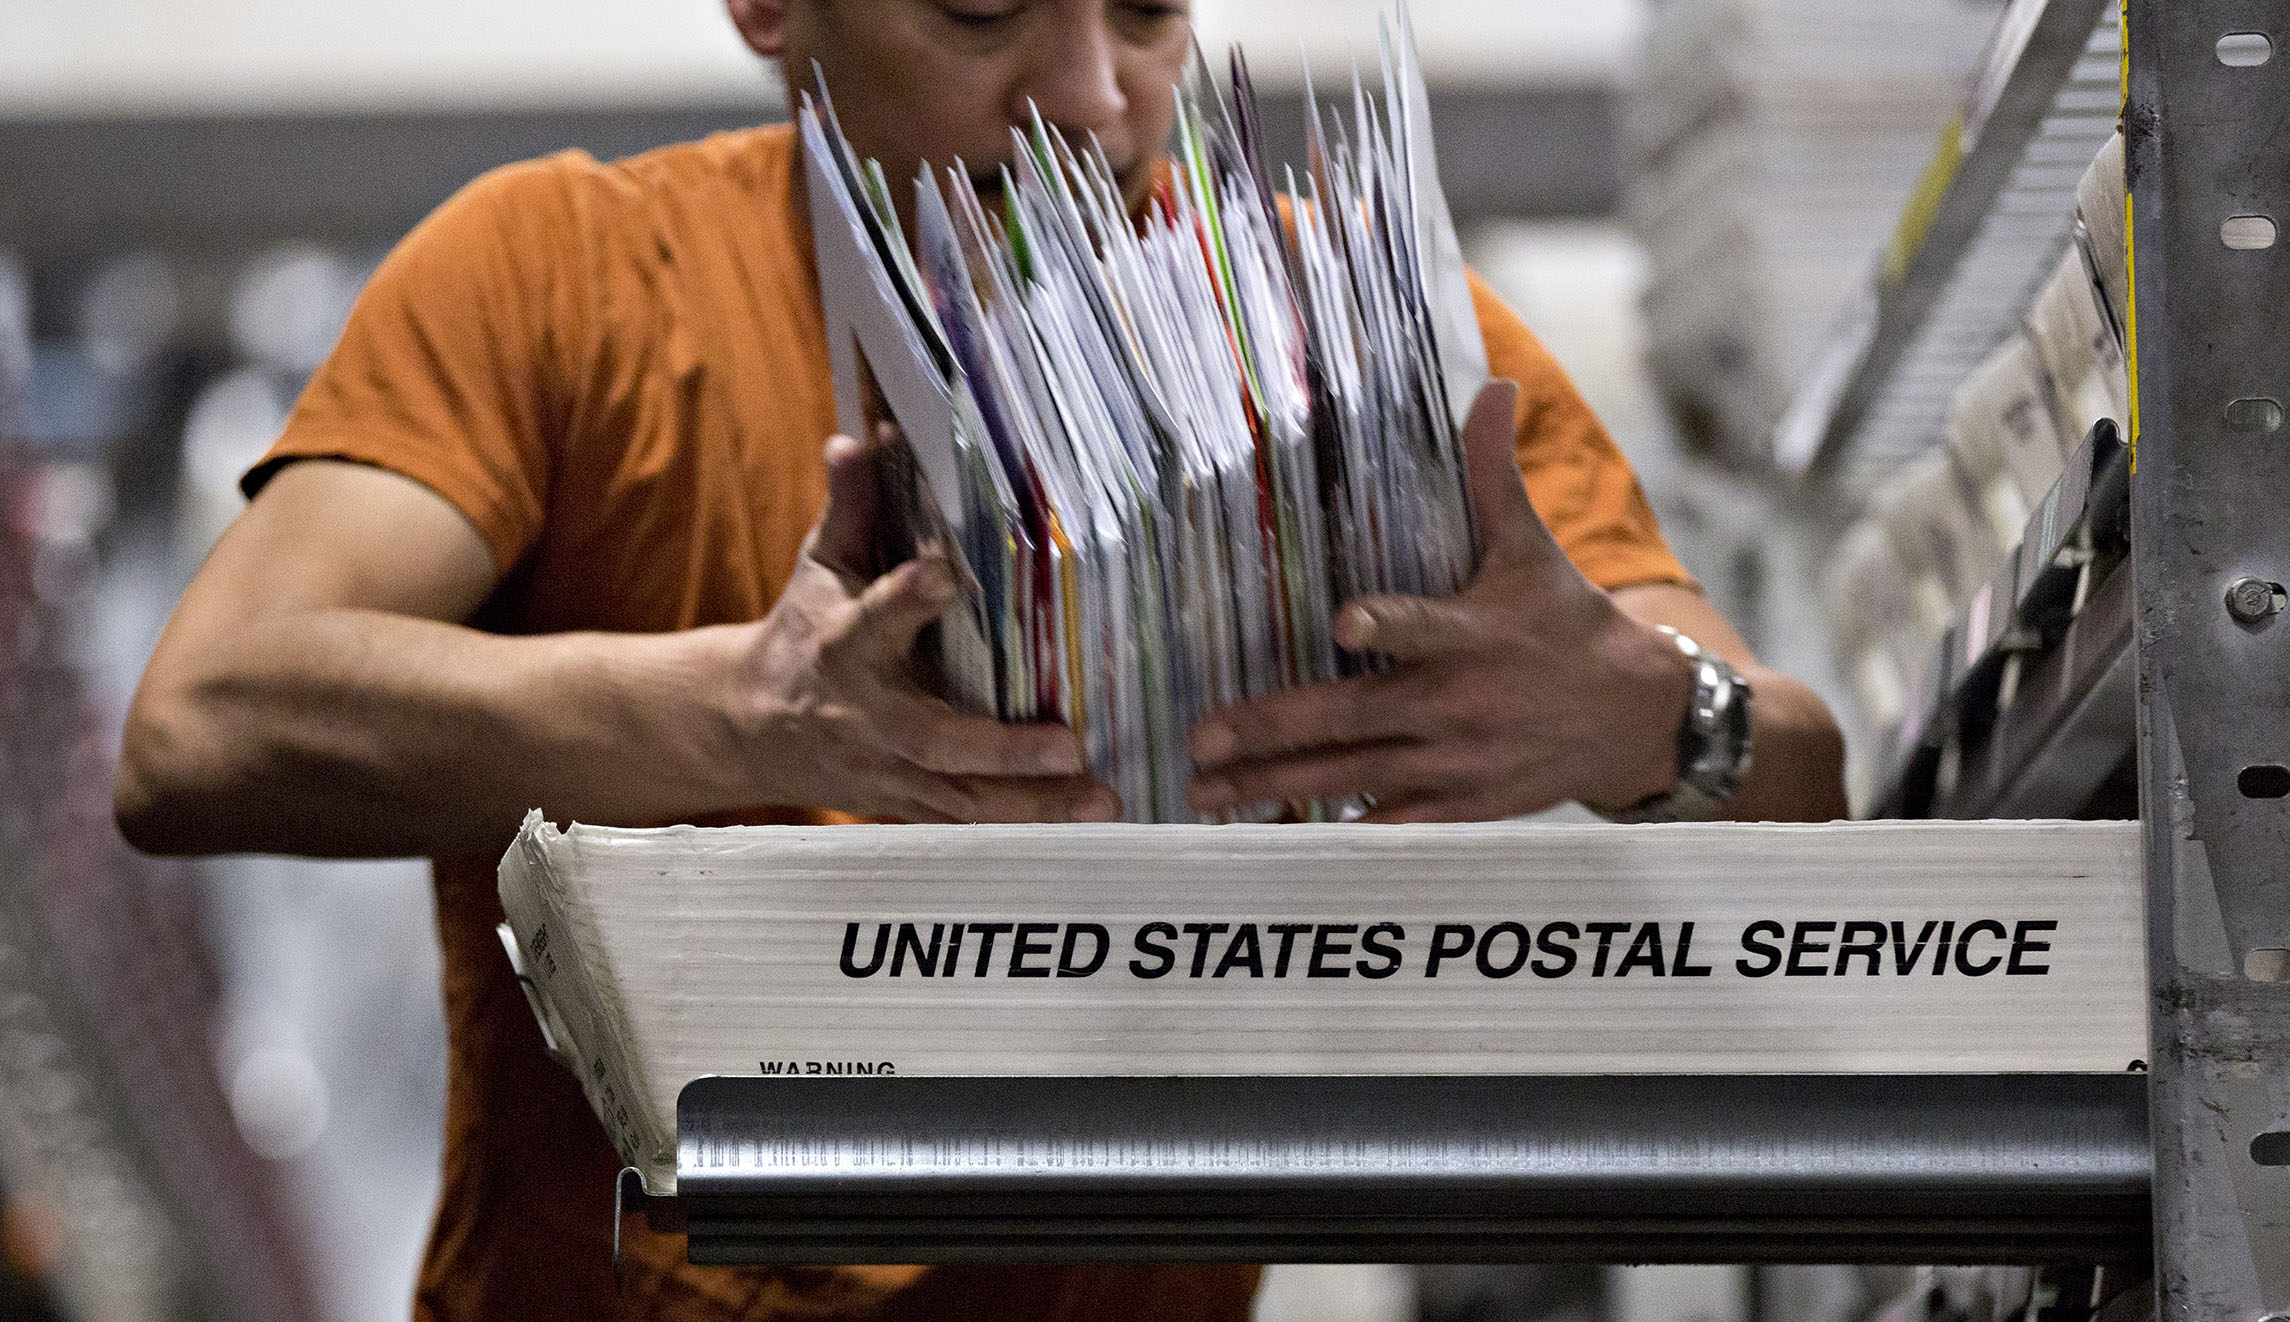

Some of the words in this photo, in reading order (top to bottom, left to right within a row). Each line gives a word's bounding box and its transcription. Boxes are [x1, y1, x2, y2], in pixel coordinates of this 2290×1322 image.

[839, 922, 1110, 978] UNITED
[1129, 921, 1405, 979] STATES
[1424, 921, 1712, 979] POSTAL
[1736, 919, 2058, 978] SERVICE
[760, 1061, 895, 1075] WARNING
